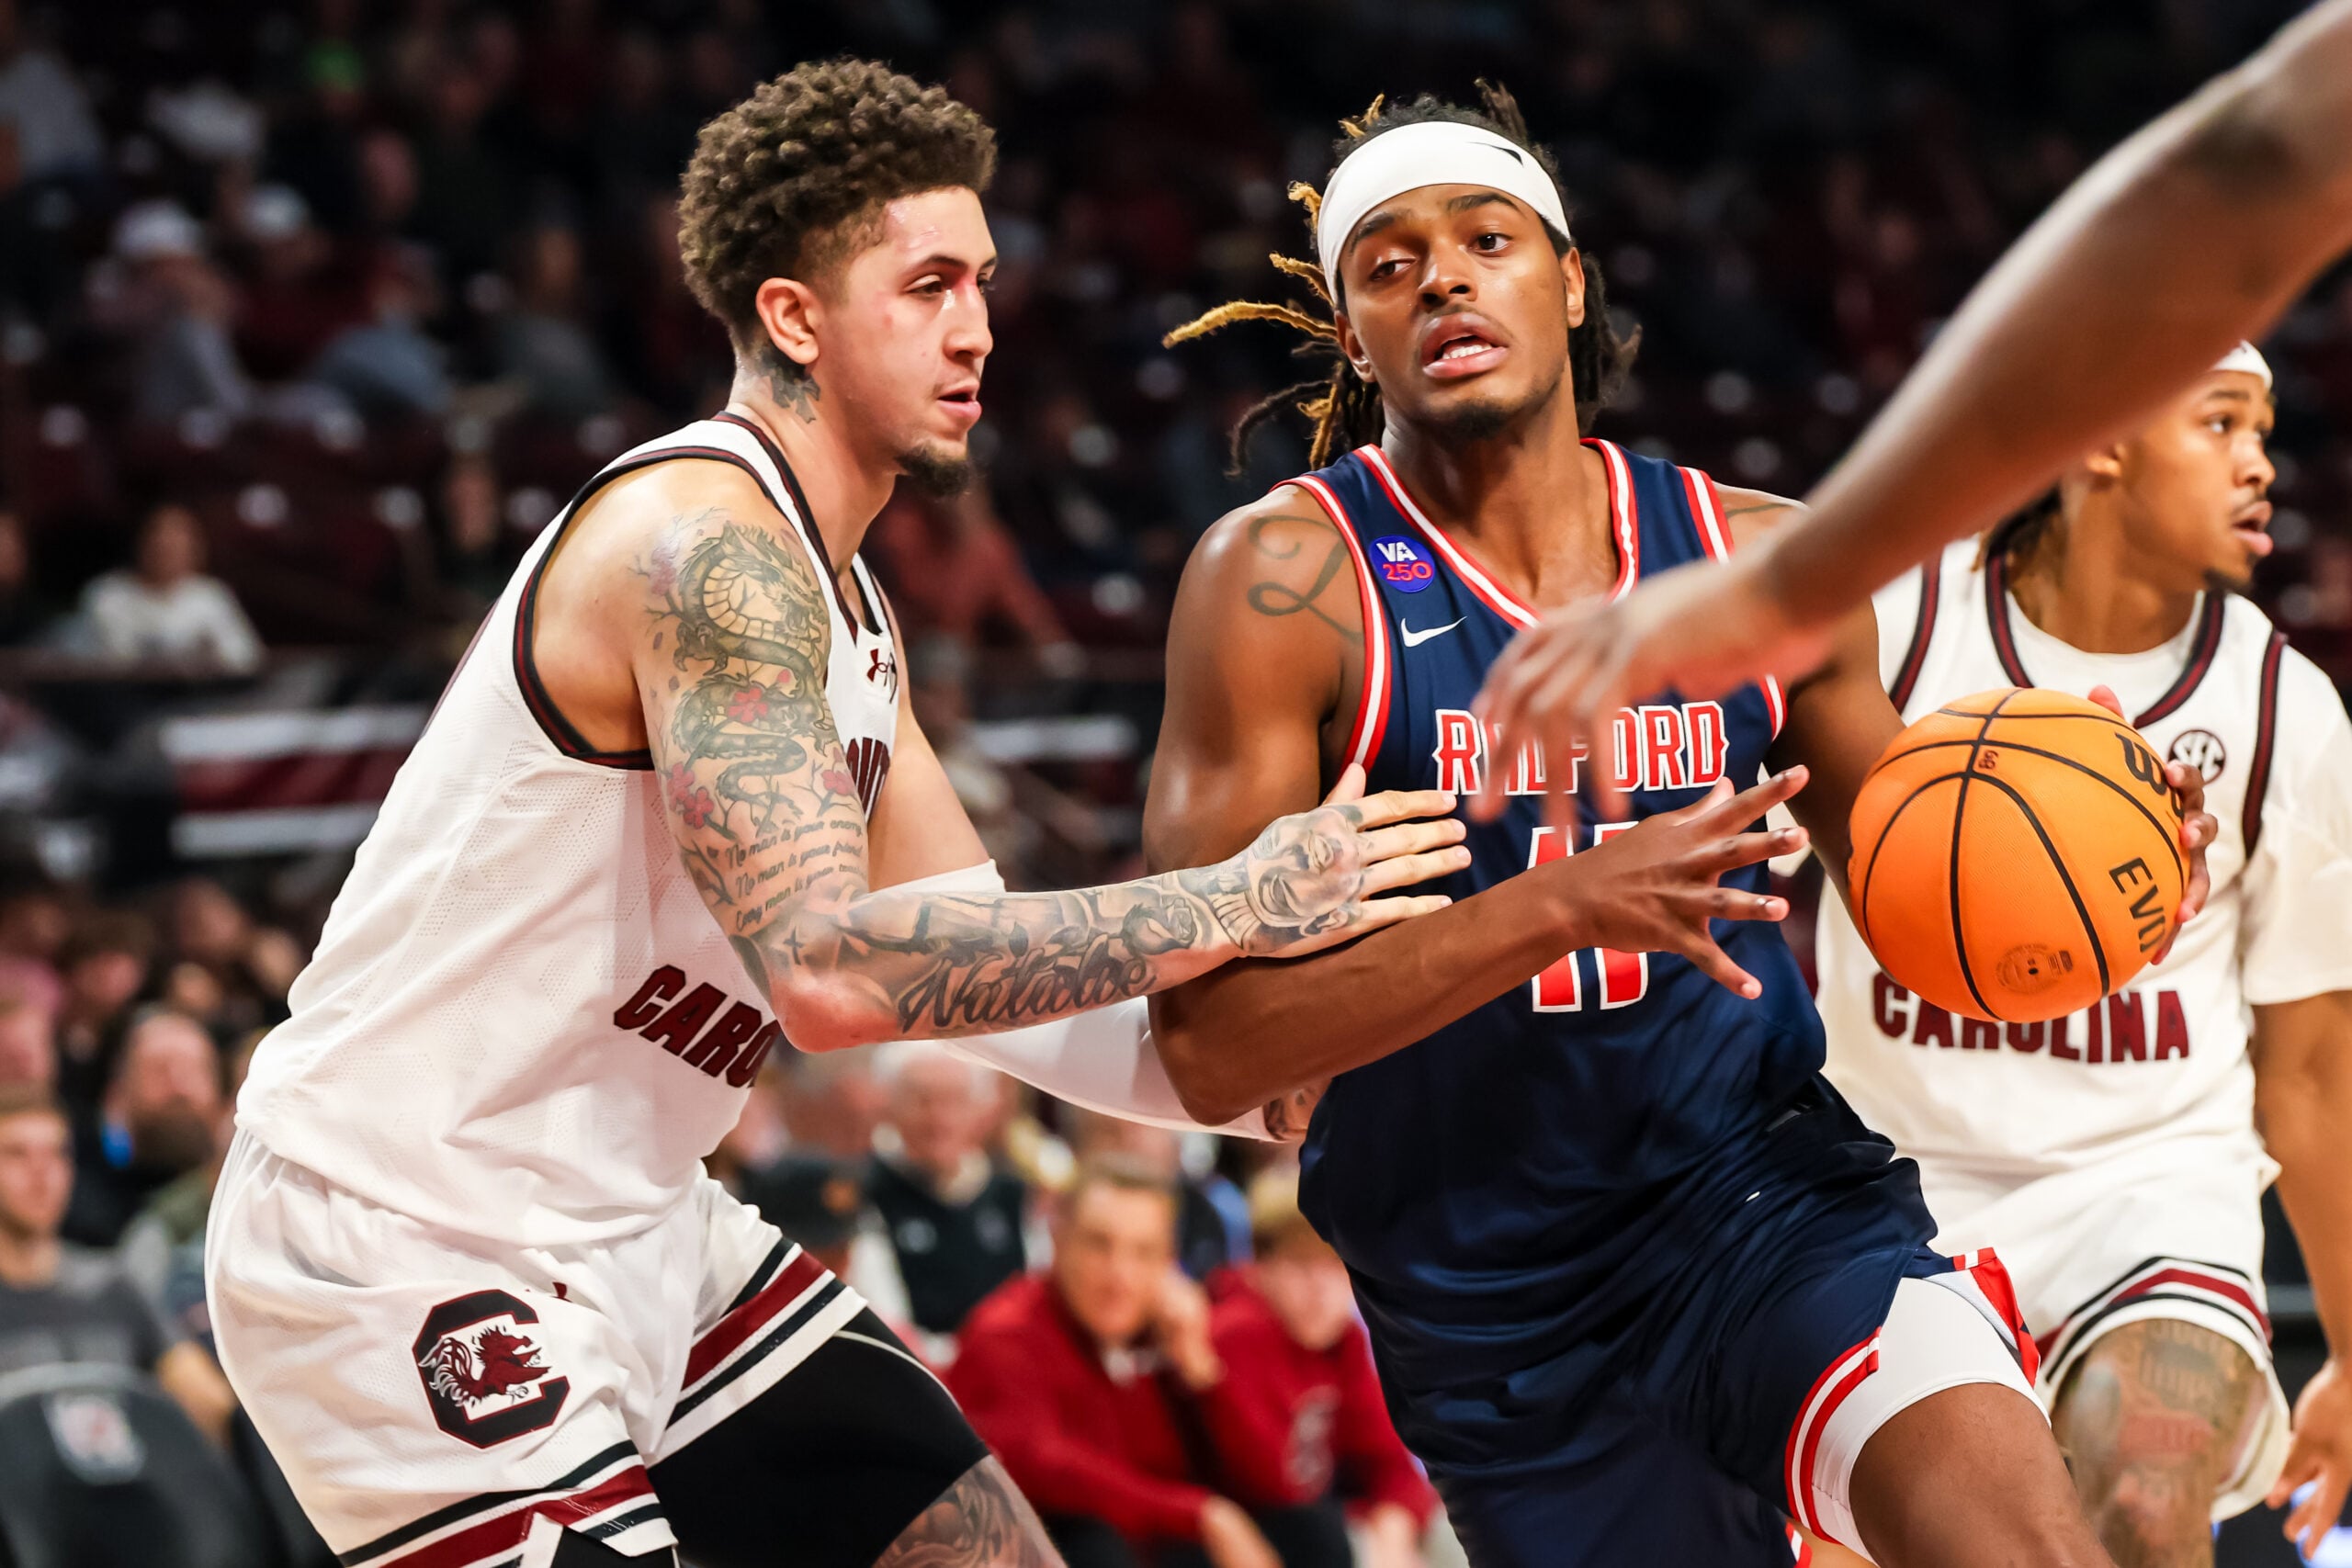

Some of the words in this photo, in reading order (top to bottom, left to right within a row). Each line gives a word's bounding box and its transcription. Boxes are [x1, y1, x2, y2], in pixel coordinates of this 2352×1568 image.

[1375, 541, 1418, 562] VA
[1382, 562, 1433, 581] 250
[750, 836, 777, 855] man
[758, 862, 784, 883] man
[765, 887, 791, 911] man
[2109, 857, 2166, 953] EVO
[614, 964, 782, 1089] CARO
